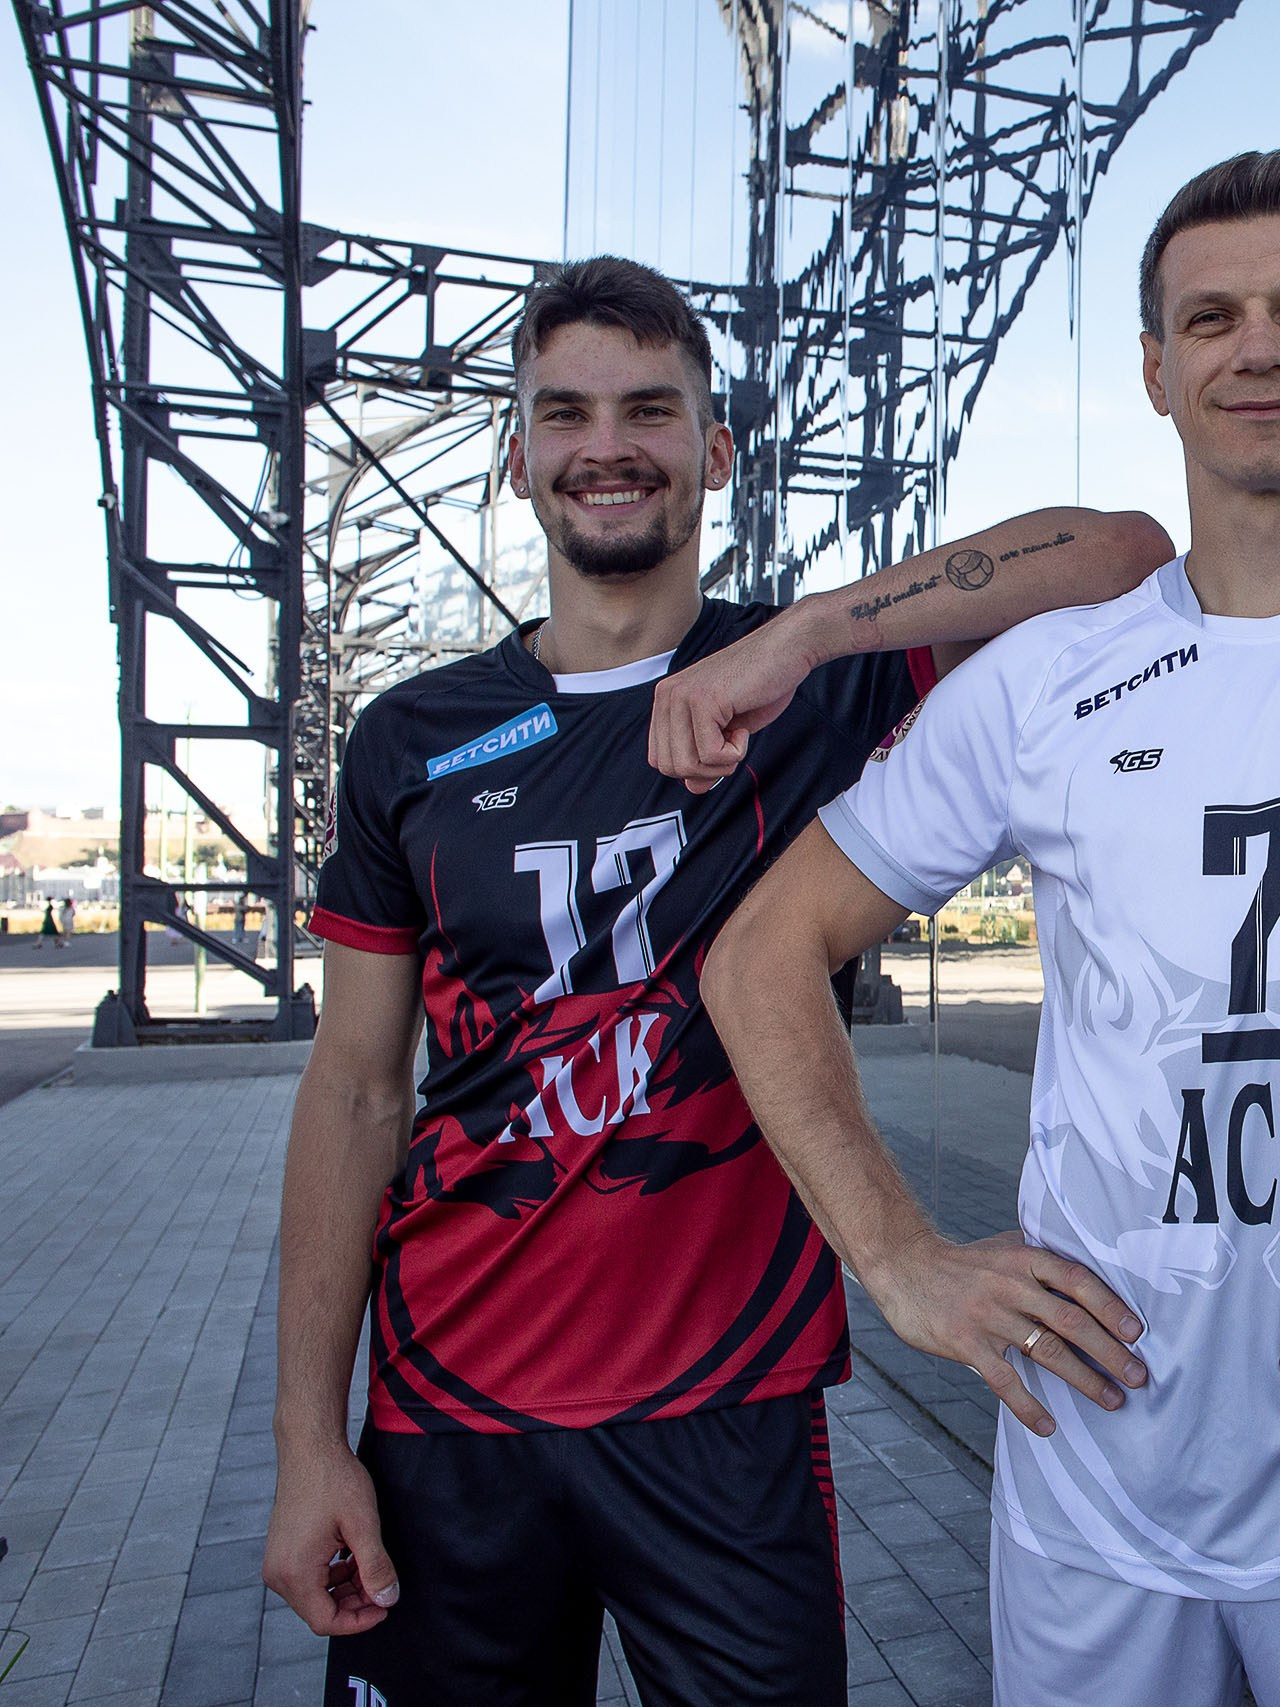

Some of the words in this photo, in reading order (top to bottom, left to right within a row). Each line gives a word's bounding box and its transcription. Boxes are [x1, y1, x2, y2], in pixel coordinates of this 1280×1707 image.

[1074, 643, 1199, 721] БЕТСИТИ
[433, 711, 550, 775] БЕТСИТИ
[514, 810, 687, 1004] 17
